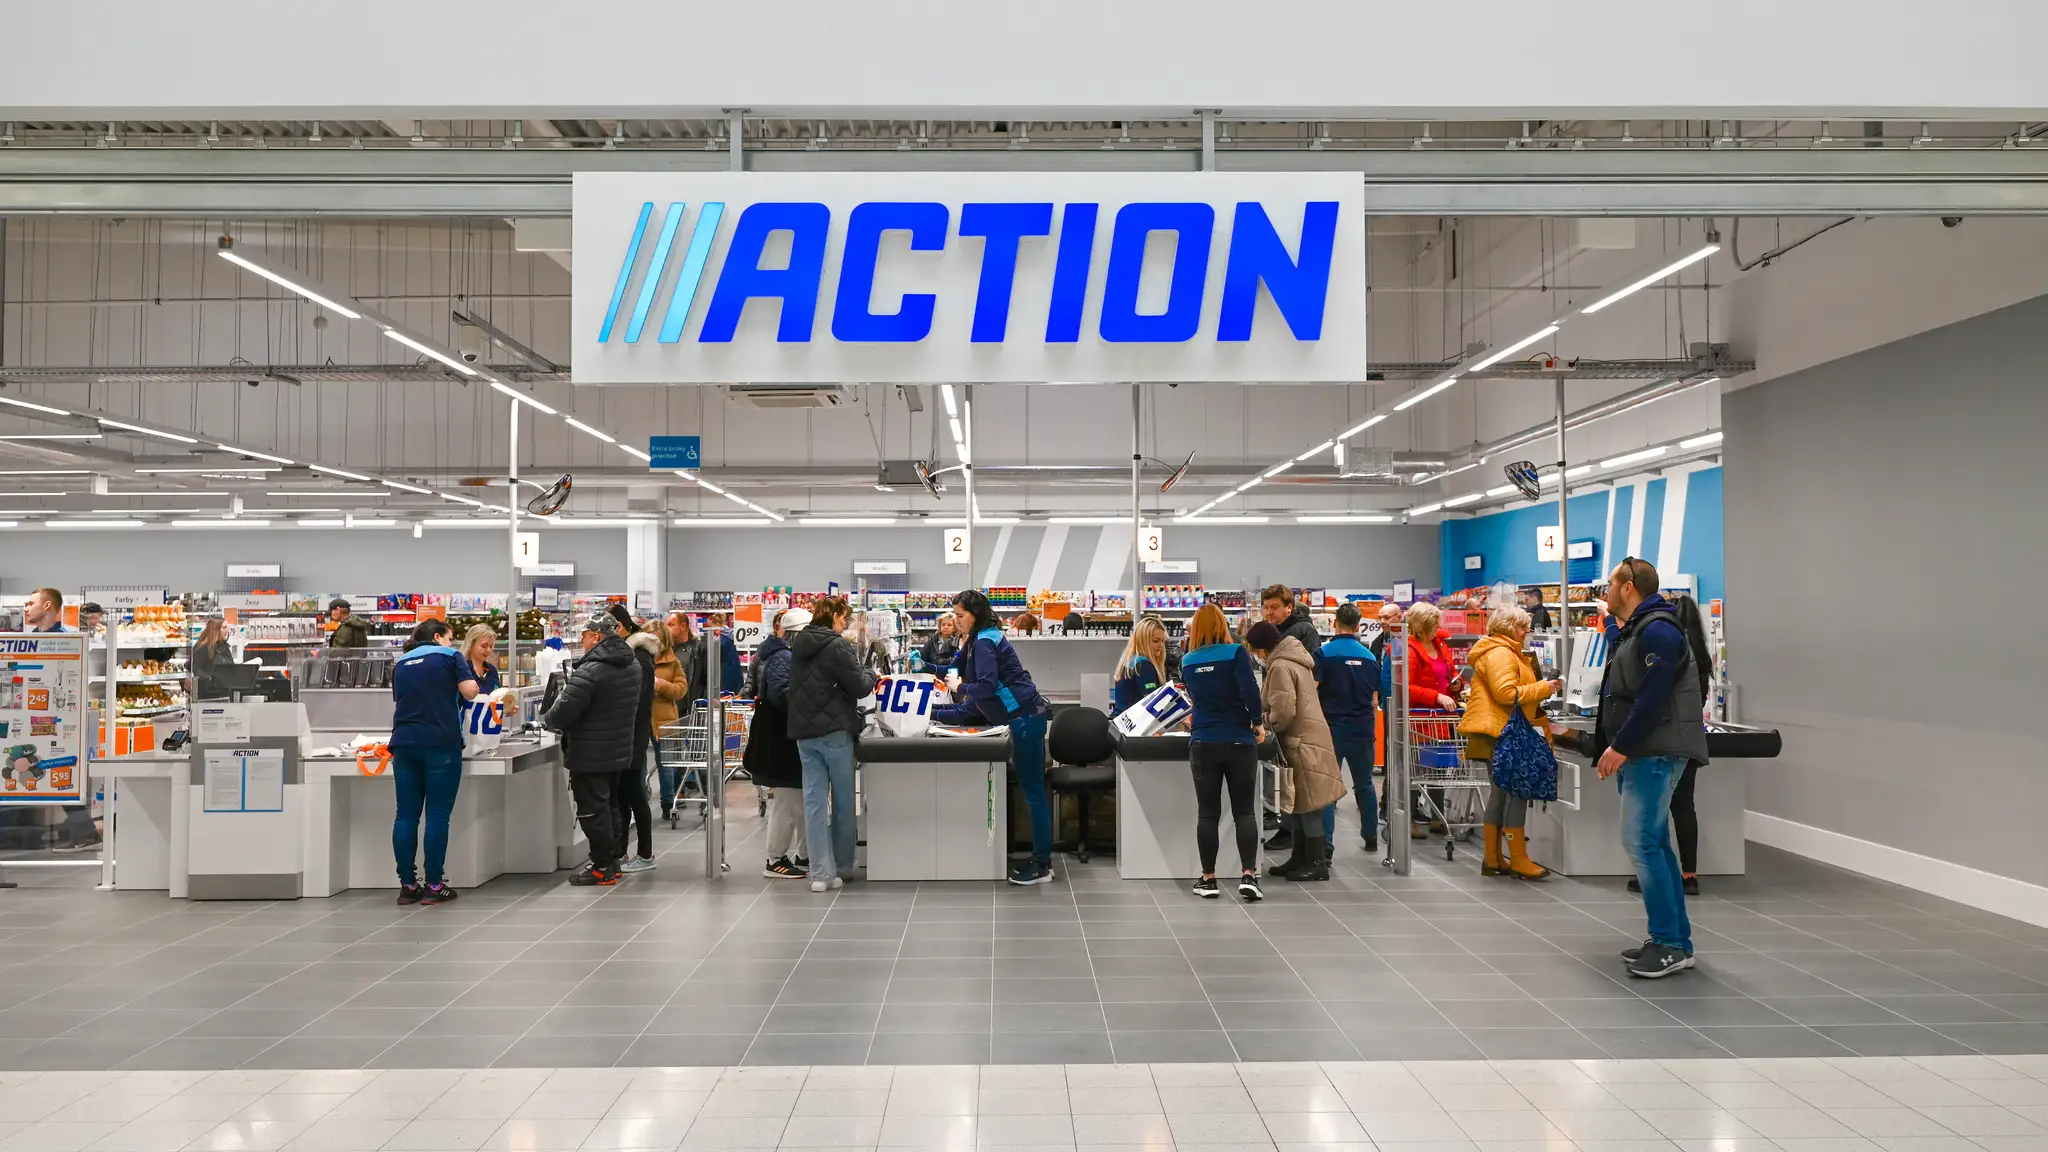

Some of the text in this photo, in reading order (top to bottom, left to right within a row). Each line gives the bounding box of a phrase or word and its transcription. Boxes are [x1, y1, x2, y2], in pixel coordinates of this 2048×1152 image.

[698, 202, 1340, 343] ACTION
[522, 541, 528, 555] 1
[952, 537, 962, 551] 2
[1149, 536, 1158, 550] 3
[1544, 536, 1554, 549] 4
[115, 596, 134, 604] Farby
[1197, 665, 1215, 673] ACTION
[52, 772, 69, 783] 595
